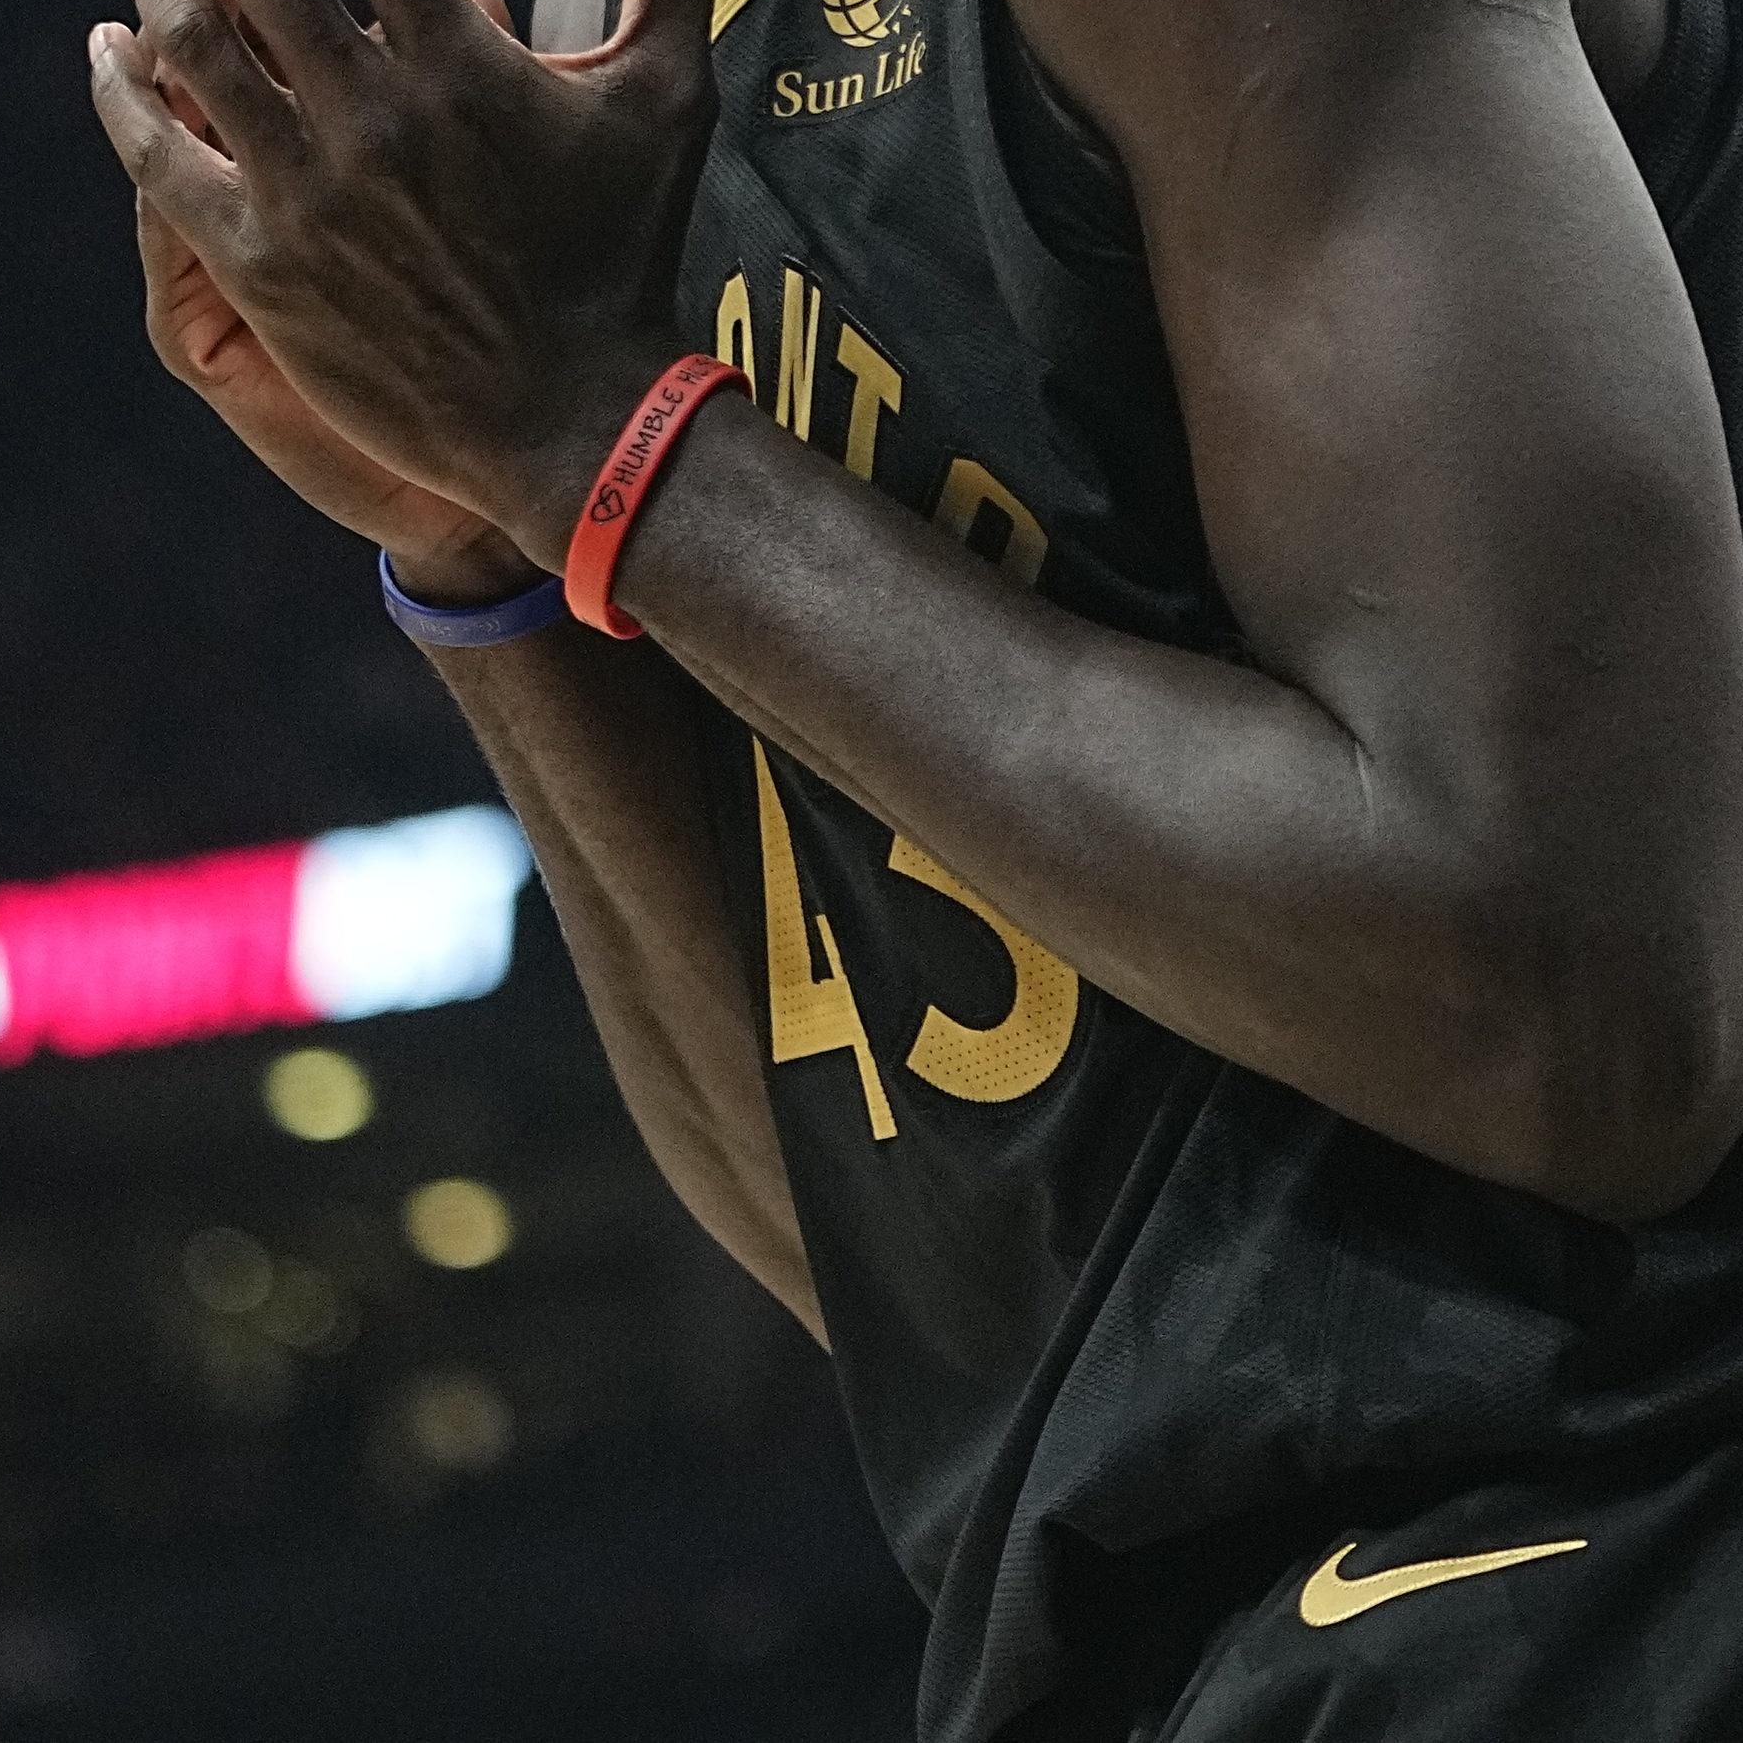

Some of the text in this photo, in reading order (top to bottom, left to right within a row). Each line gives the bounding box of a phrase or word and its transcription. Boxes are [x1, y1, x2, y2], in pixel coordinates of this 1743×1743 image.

[773, 31, 926, 118] Sun Life
[612, 387, 683, 485] HUMBLE
[716, 267, 1049, 586] ONTO
